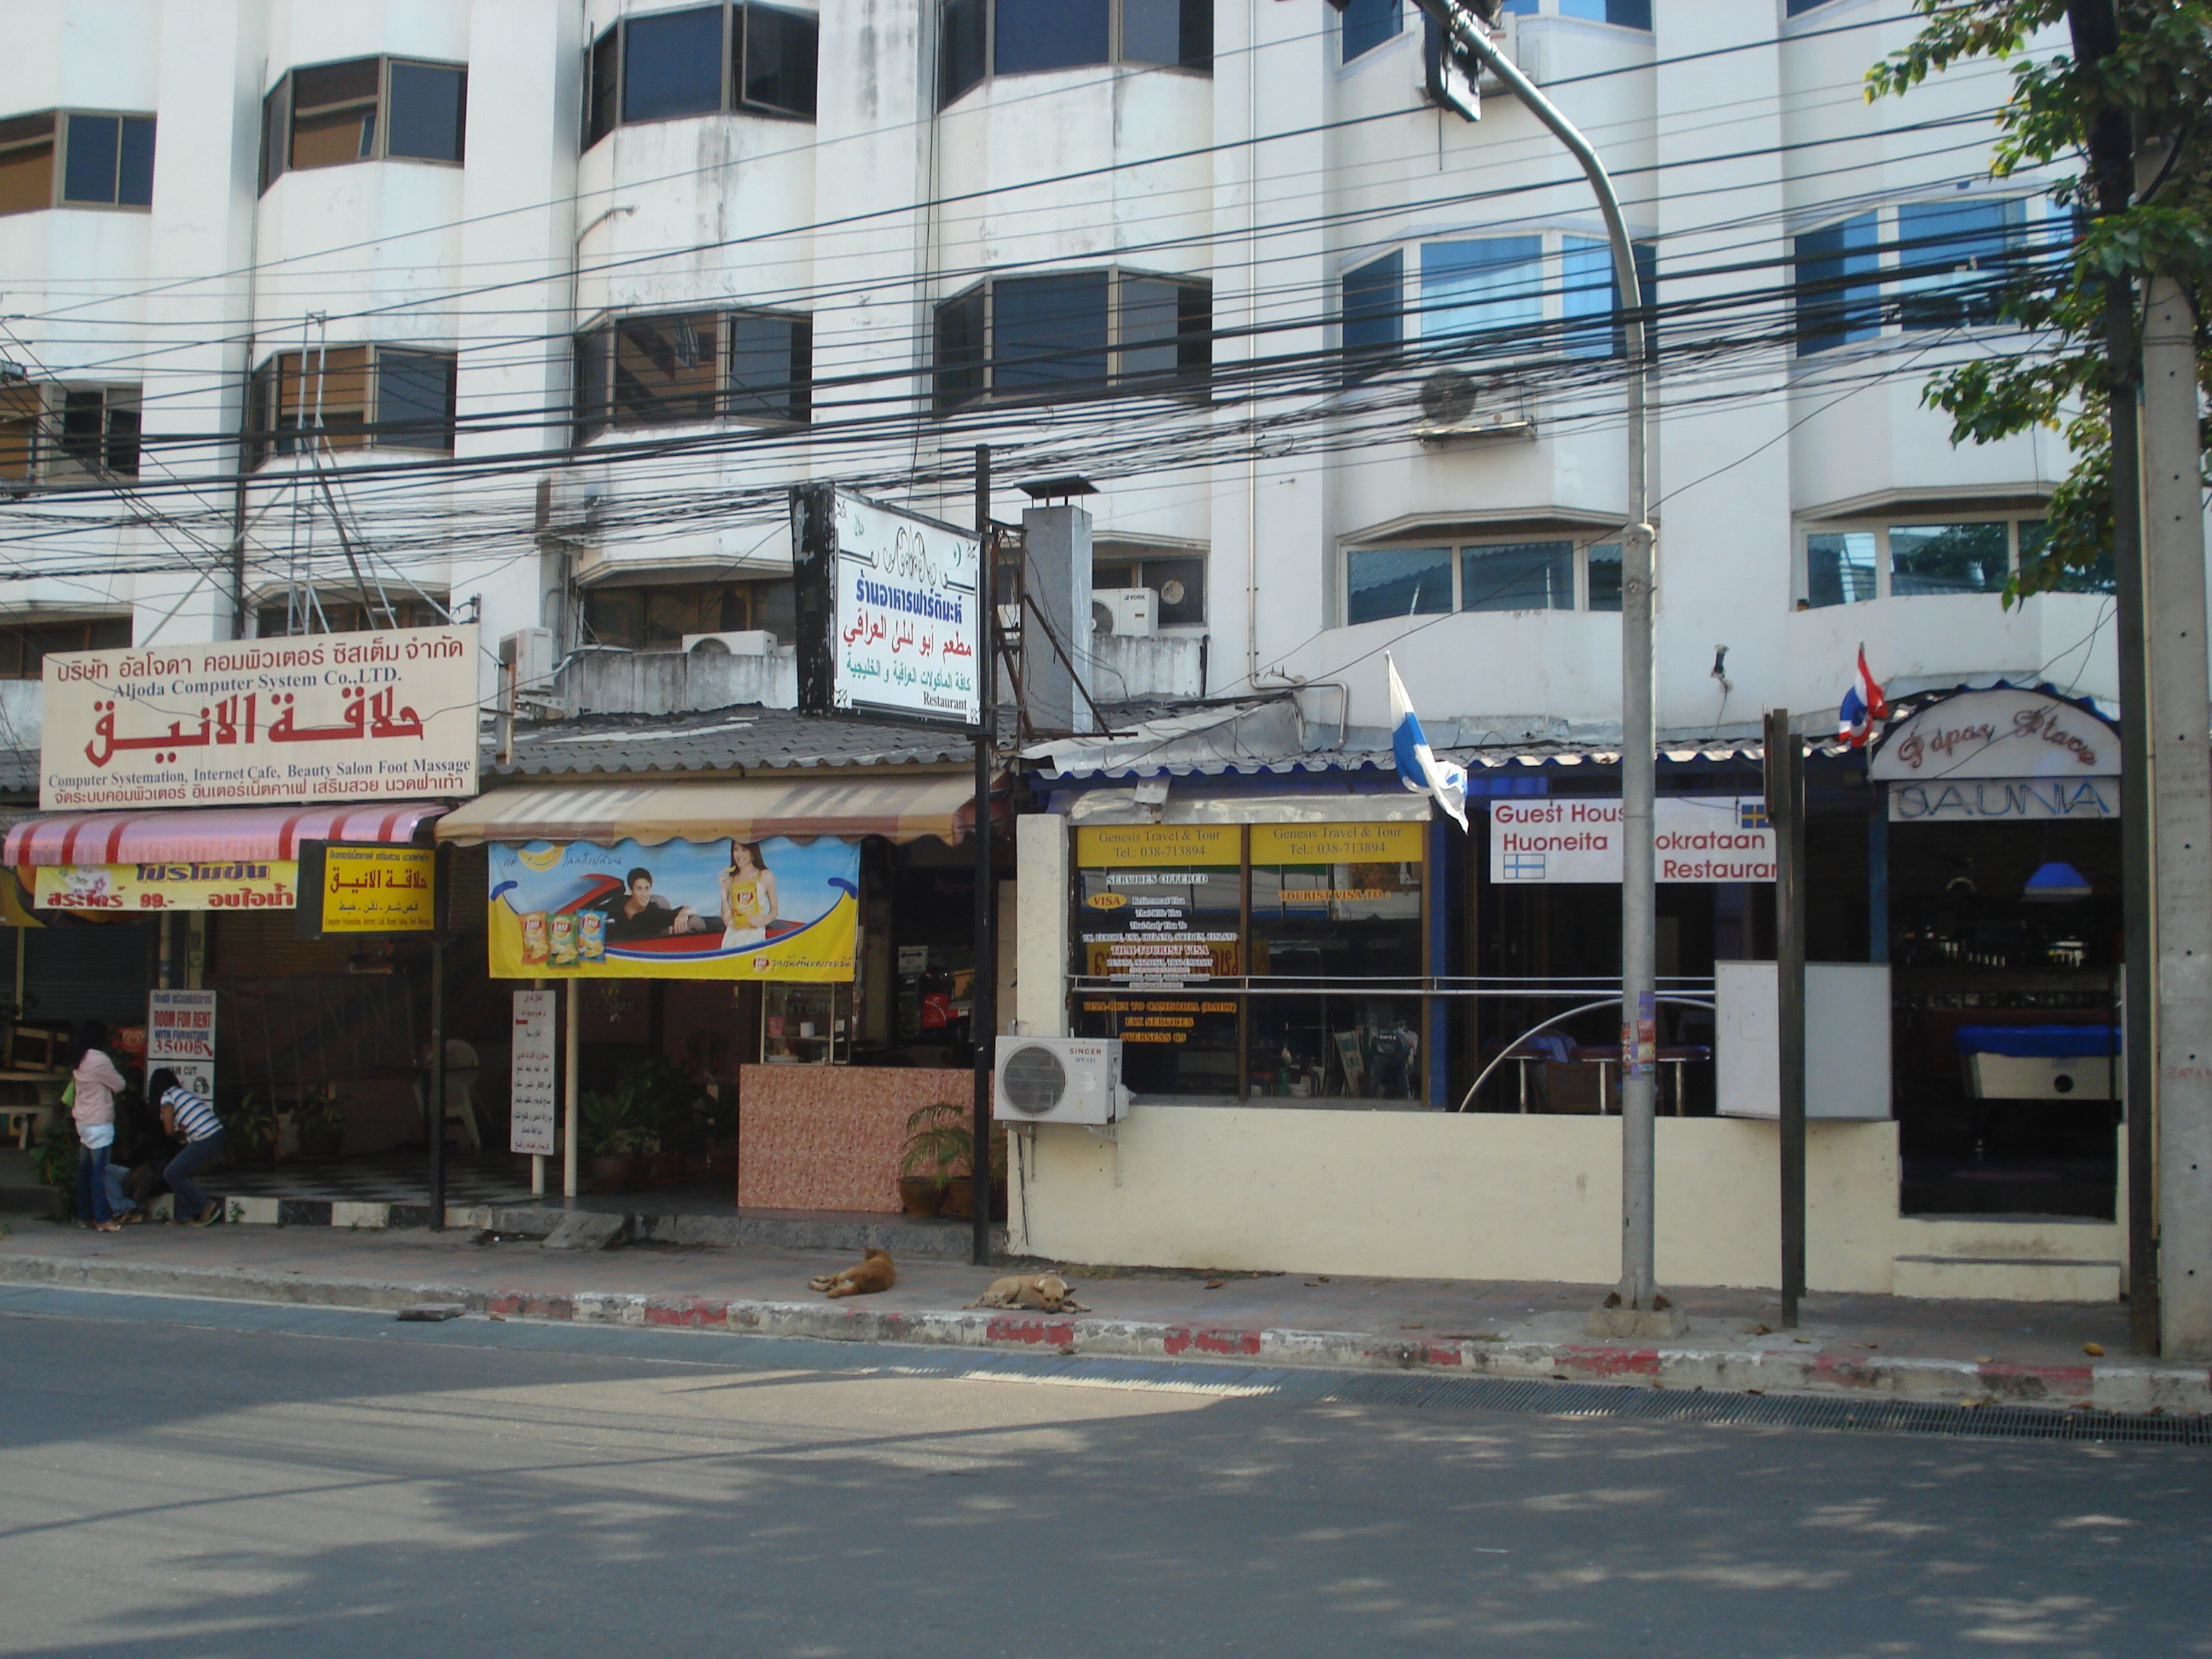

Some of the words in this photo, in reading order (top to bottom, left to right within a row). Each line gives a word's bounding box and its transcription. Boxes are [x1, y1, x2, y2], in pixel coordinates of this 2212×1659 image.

[843, 607, 886, 647] العراقي
[919, 624, 934, 657] أبو
[943, 630, 972, 665] مطعم
[58, 658, 108, 682] บริษัท
[120, 651, 192, 678] อัลโจดา
[204, 643, 324, 673] คอมพิวเตอร์
[333, 637, 399, 664] ซิสเต็ม
[405, 634, 464, 660] จำกัด
[846, 652, 881, 680] الخليجية
[113, 683, 165, 700] Aljoda
[171, 678, 253, 696] Computer
[258, 673, 317, 691] System
[324, 667, 402, 685] Co.,LTD.
[884, 667, 889, 683] و
[893, 660, 917, 687] العراقية
[955, 671, 971, 691] كافة
[923, 691, 967, 711] Restaurant
[268, 685, 423, 742] حلاقة
[84, 693, 256, 768] الانيق
[48, 774, 107, 790] Computer
[111, 771, 189, 786] Systemation,
[194, 768, 243, 781] Internet
[248, 765, 281, 780] Cafe,
[288, 763, 332, 779] Beauty
[336, 762, 372, 775] Salon
[379, 760, 408, 773] Foot
[413, 758, 471, 774] Massage
[55, 785, 186, 804] จัดระบบคอมพิวเตอร์
[313, 778, 379, 793] เสริมสวย
[1897, 783, 2110, 818] SAUNA
[1495, 804, 1563, 824] Guest
[1571, 804, 1624, 823] Hous
[1099, 832, 1141, 843] Genesis
[1143, 830, 1179, 842] Travel
[1182, 830, 1191, 840] &
[1195, 830, 1221, 840] Tour
[1274, 827, 1318, 840] Genesis
[1321, 826, 1357, 839] Travel
[1360, 827, 1370, 837] &
[1375, 826, 1402, 837] Tour
[1503, 832, 1608, 851] Huoneita
[1141, 845, 1205, 857] 038-713894
[1317, 842, 1385, 854] 038-713894
[330, 866, 381, 894] الانيق
[385, 868, 428, 891] حلاقة
[1107, 874, 1158, 885] SERVICES
[1159, 873, 1209, 884] OFFERED
[207, 882, 294, 907] อบไอน้ำ
[1094, 896, 1121, 907] VISA
[1279, 889, 1331, 902] TOURIST
[1334, 889, 1362, 901] VISA
[1366, 889, 1382, 900] TO
[1185, 945, 1210, 955] VISA
[1130, 1002, 1145, 1011] TO
[1146, 1002, 1200, 1012] CAMBODIA
[154, 1010, 175, 1027] ROOM
[177, 1011, 191, 1028] FOR
[193, 1012, 211, 1028] RENT
[1145, 1017, 1194, 1027] SERVICES
[154, 1030, 171, 1039] WITH
[173, 1030, 209, 1041] FURNITURE
[1120, 1033, 1172, 1042] OVERSEAS
[184, 1066, 197, 1076] CUT
